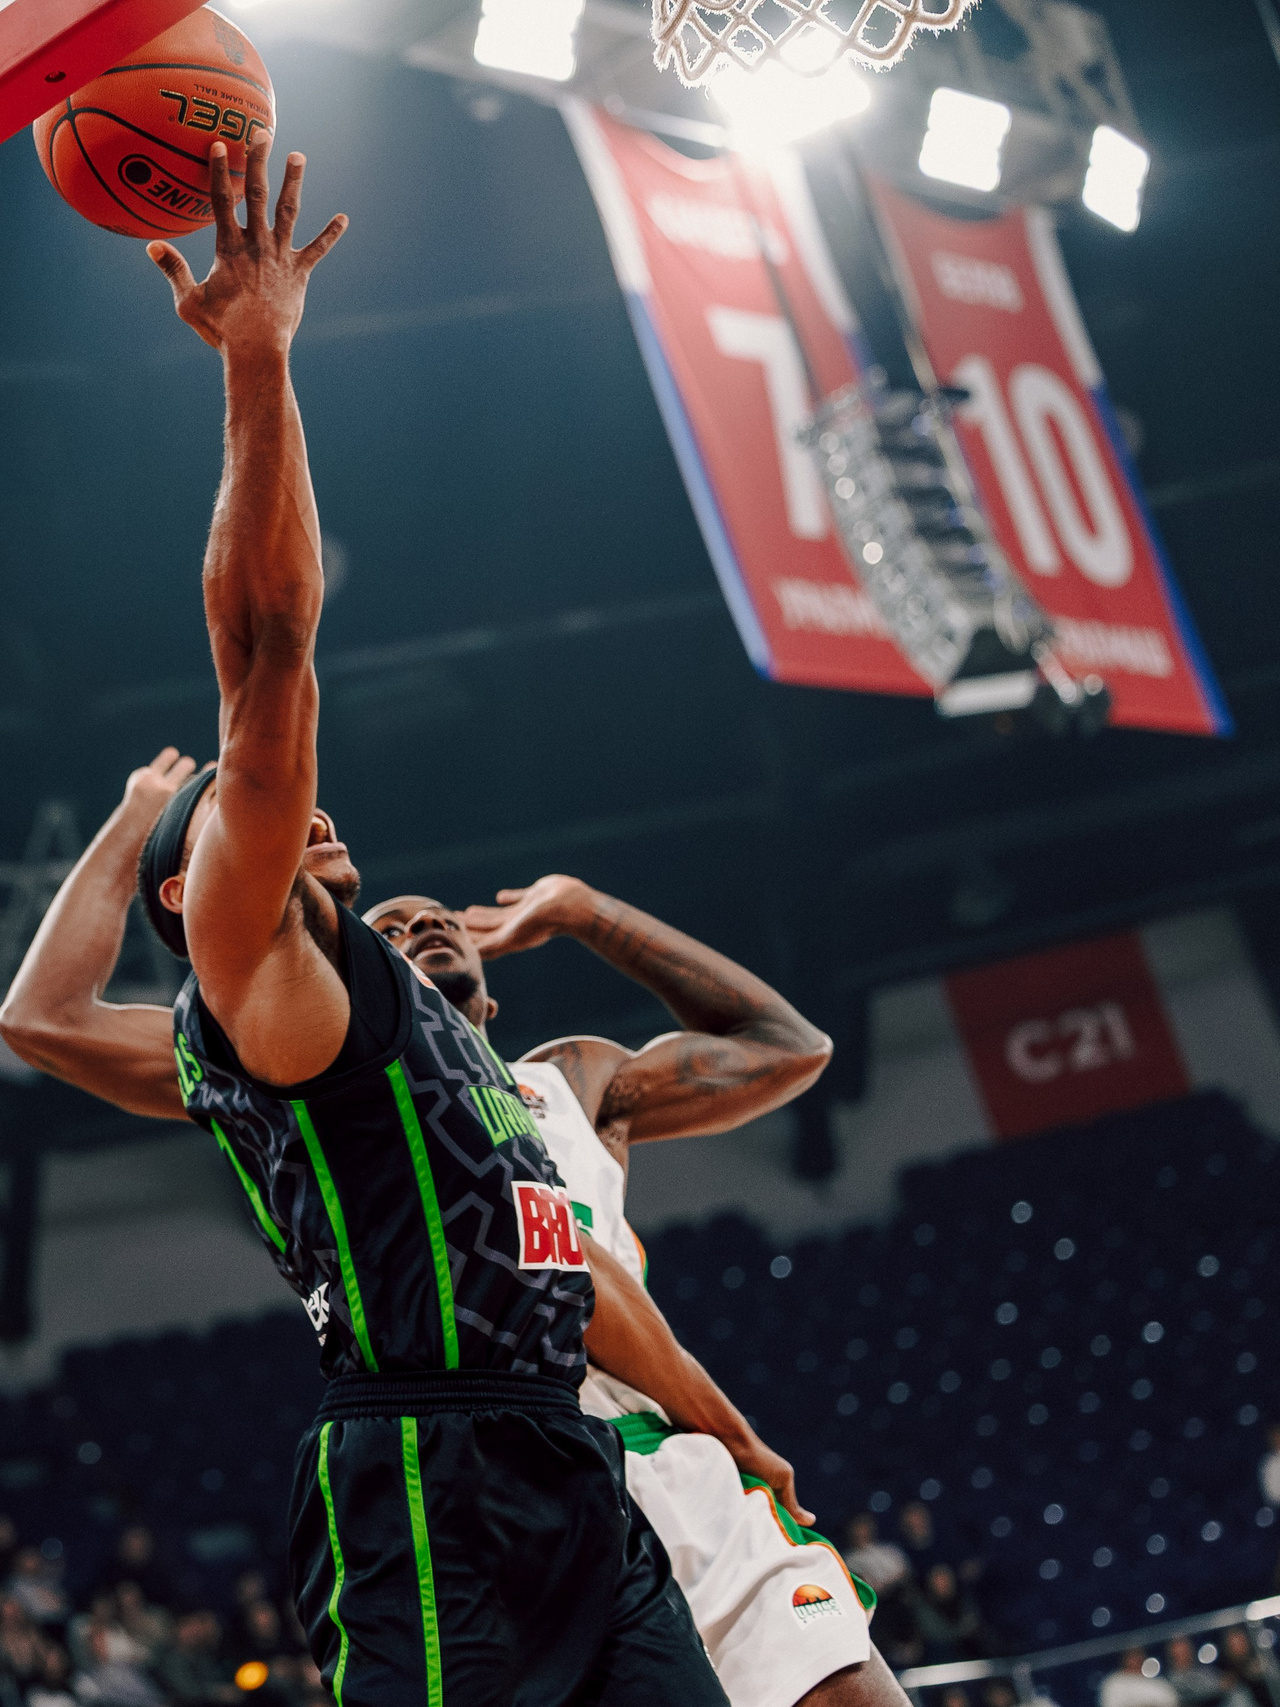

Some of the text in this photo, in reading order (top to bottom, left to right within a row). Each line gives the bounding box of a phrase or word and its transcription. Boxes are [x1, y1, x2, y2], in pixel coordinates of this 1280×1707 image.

[194, 84, 218, 96] BALL
[147, 180, 213, 217] NLINE
[708, 306, 830, 541] 7
[952, 356, 1133, 588] 10
[793, 1600, 839, 1620] UNICS
